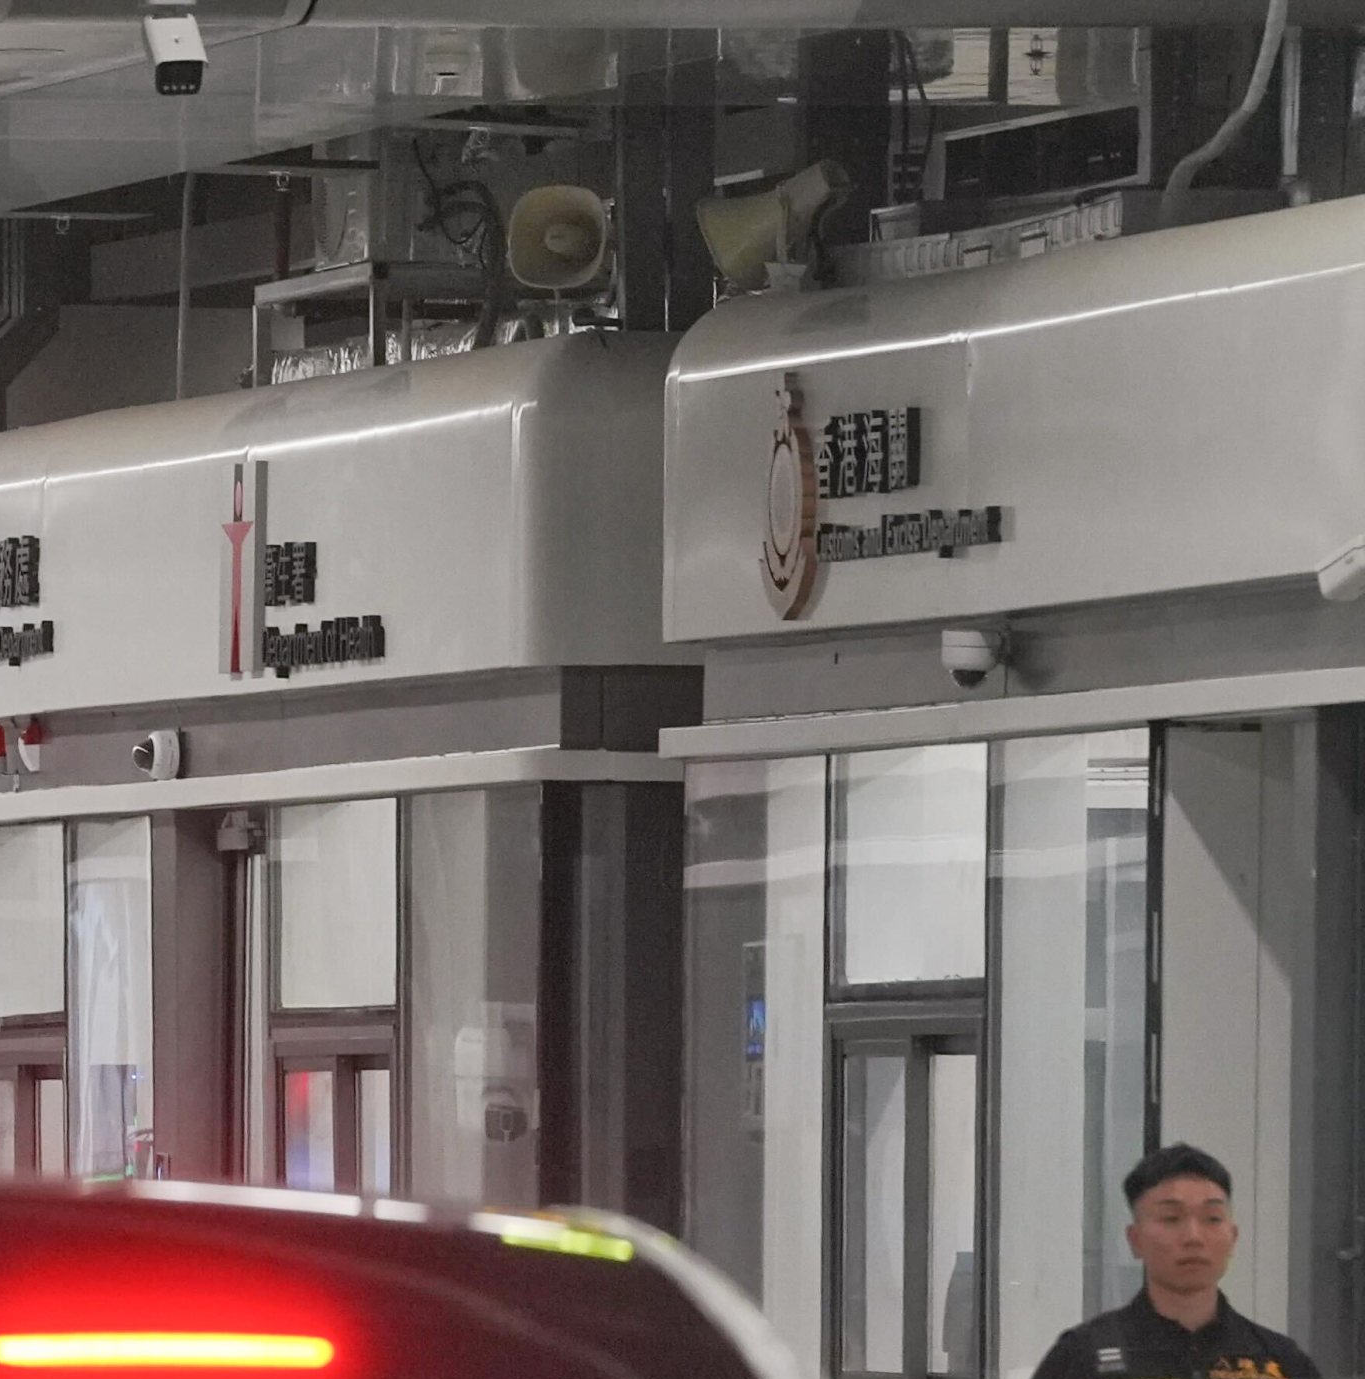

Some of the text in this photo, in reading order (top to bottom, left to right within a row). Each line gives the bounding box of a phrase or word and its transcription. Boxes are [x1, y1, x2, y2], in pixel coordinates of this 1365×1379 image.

[816, 407, 917, 498] 香港海關
[884, 514, 922, 555] Excise
